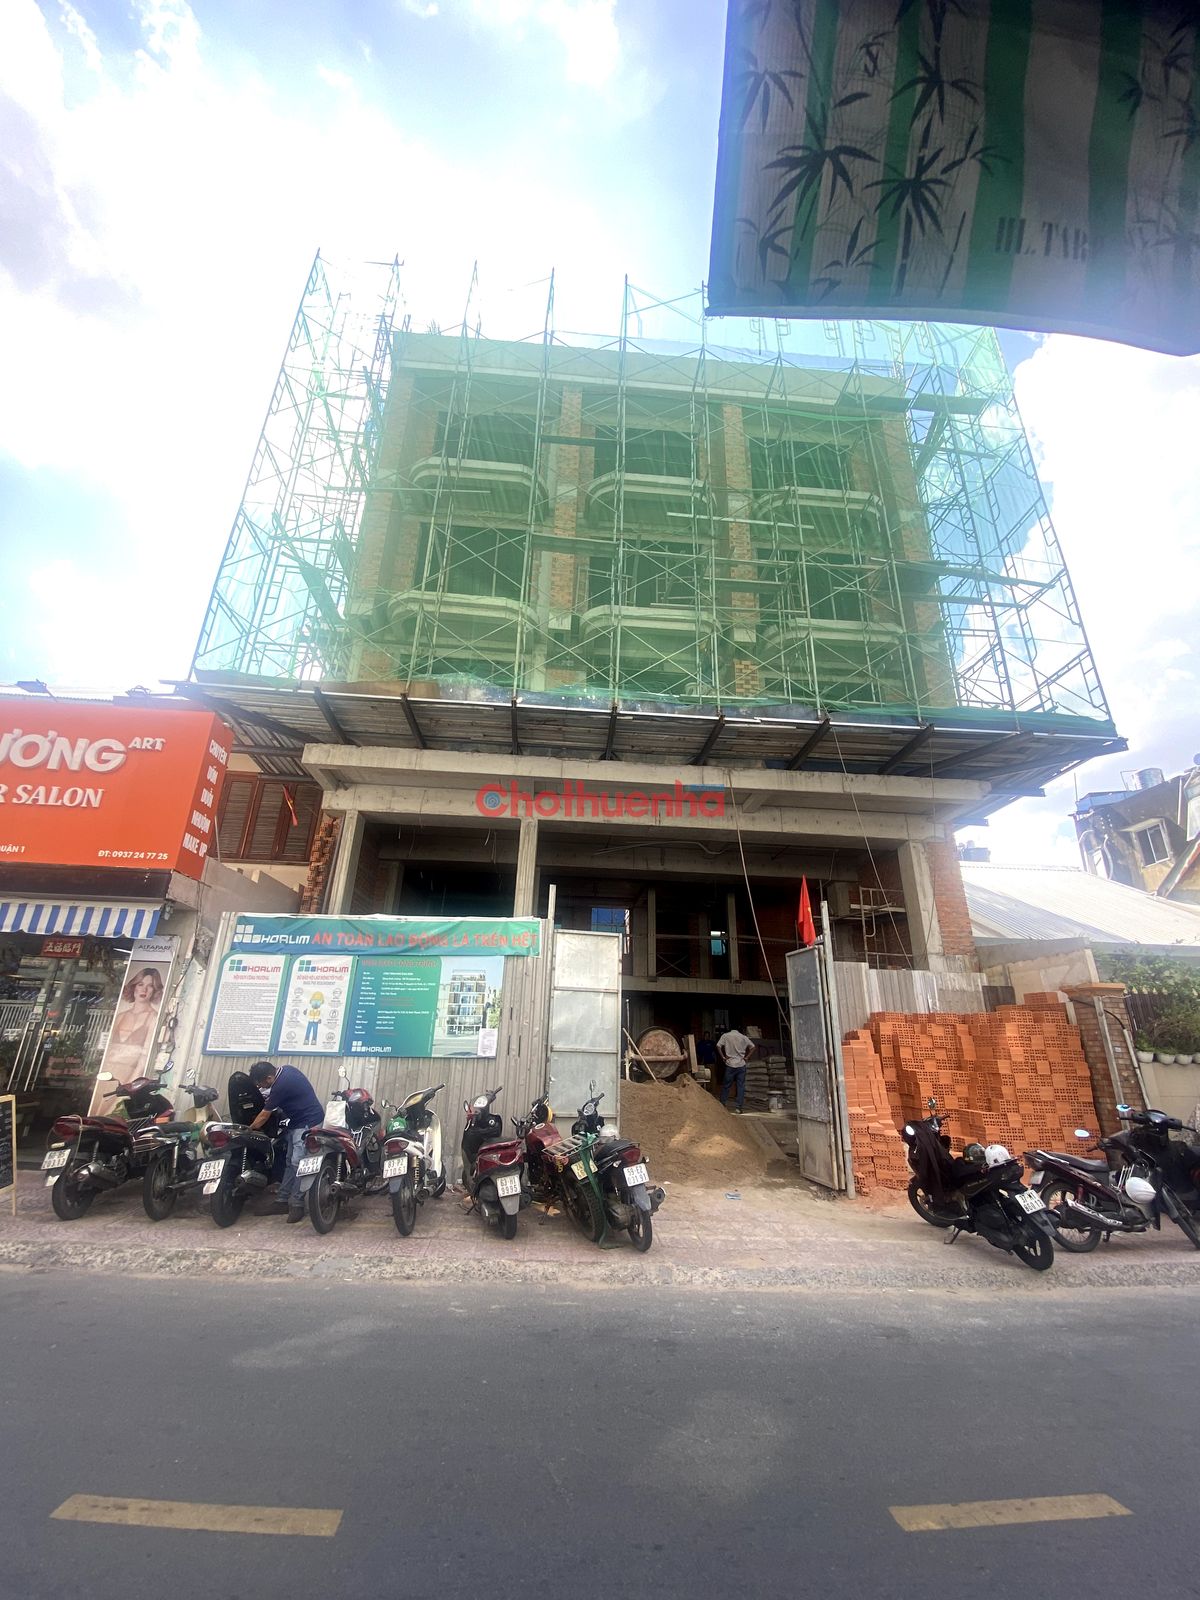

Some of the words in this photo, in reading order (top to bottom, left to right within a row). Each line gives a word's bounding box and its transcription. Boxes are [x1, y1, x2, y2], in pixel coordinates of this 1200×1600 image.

[128, 737, 166, 750] ART
[12, 784, 104, 808] SALON
[182, 832, 200, 854] MAKE
[199, 841, 208, 857] UP
[98, 849, 111, 858] ĐT:
[112, 850, 134, 859] 0937
[134, 851, 145, 859] 24
[146, 852, 156, 860] 77
[157, 852, 168, 861] 25
[311, 932, 333, 946] AN
[377, 932, 405, 948] LAO
